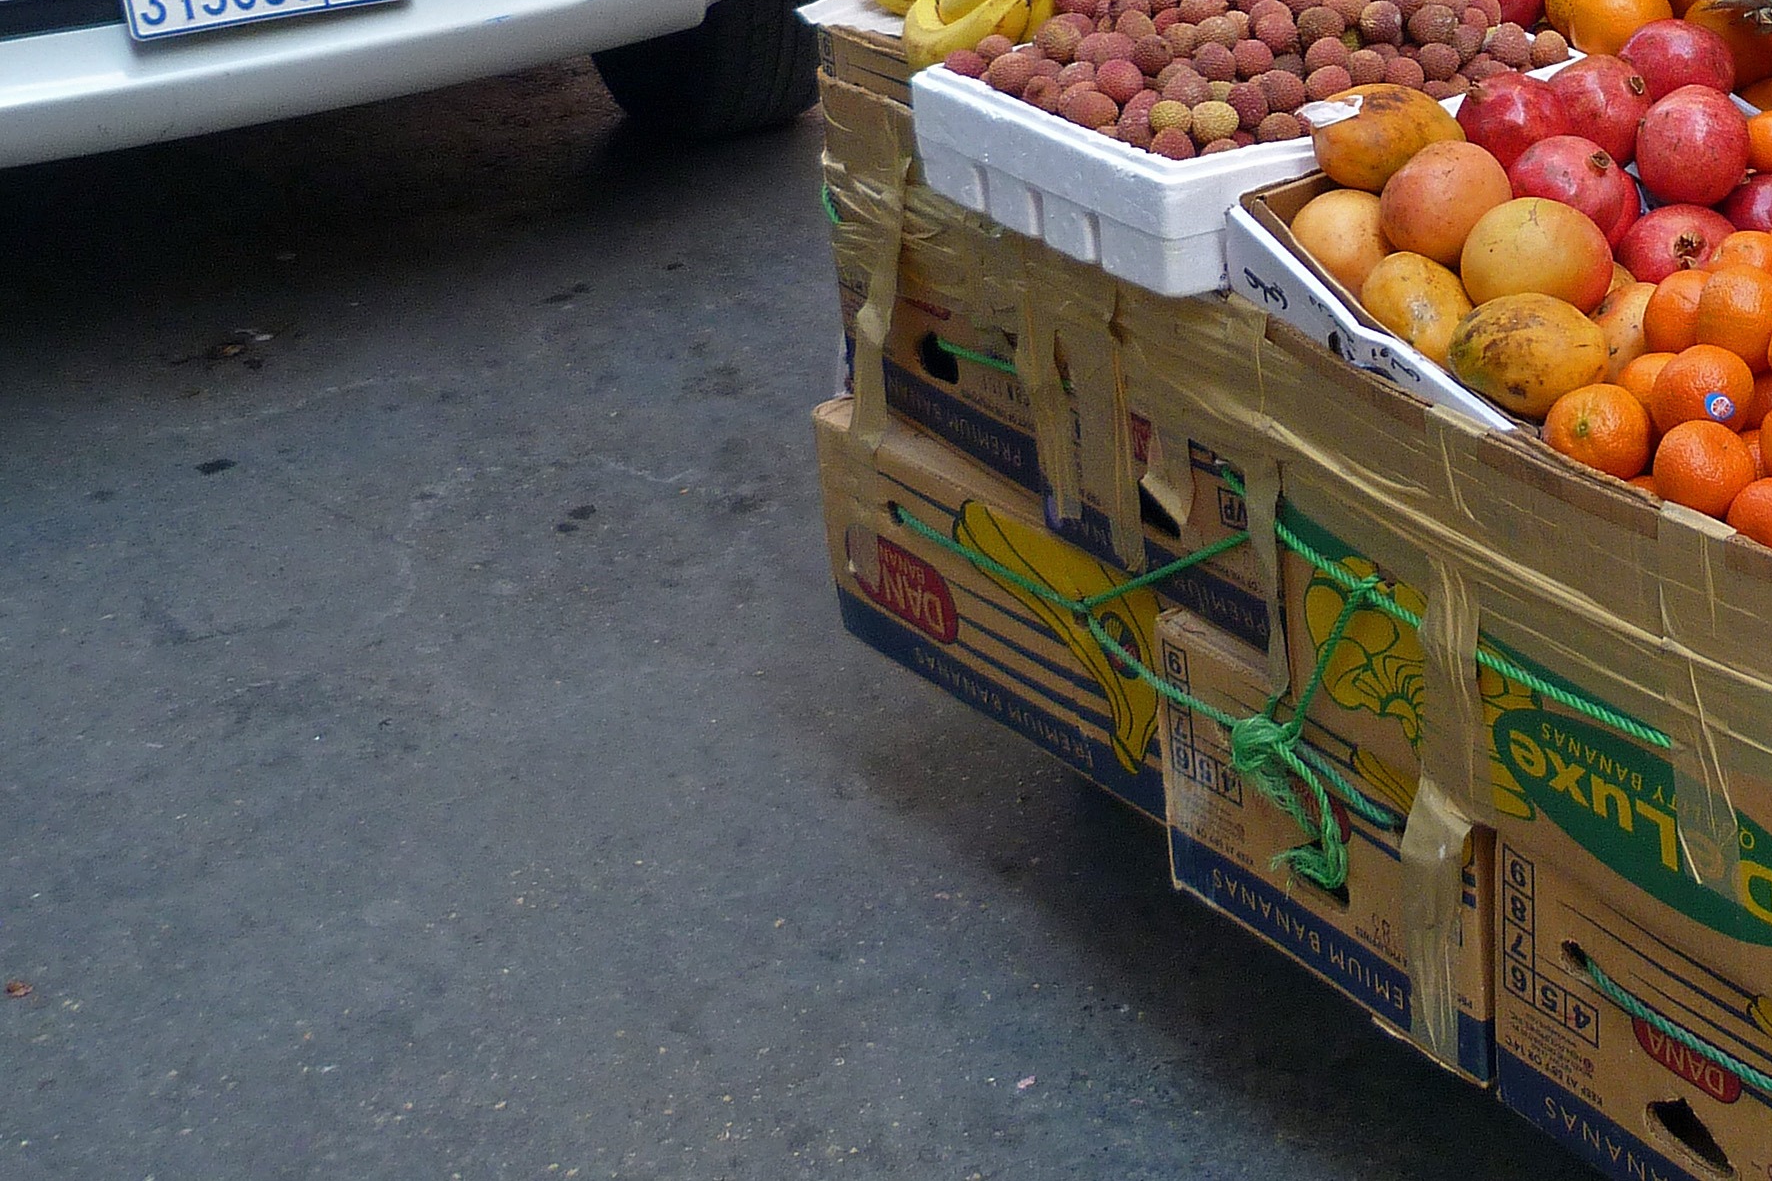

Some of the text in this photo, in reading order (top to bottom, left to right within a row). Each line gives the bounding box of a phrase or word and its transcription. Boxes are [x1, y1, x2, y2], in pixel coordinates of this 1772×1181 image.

[878, 559, 946, 637] DAN
[913, 647, 1003, 713] BANANAS
[1167, 648, 1182, 673] 9
[1175, 746, 1191, 771] 6
[1542, 722, 1644, 792] BANANAS
[1510, 858, 1527, 887] 9
[1510, 888, 1528, 920] 8
[1211, 865, 1322, 952] BANANAS
[1511, 923, 1527, 954] 7
[1511, 965, 1592, 1030] 4 5 6
[1642, 1023, 1728, 1099] DANA
